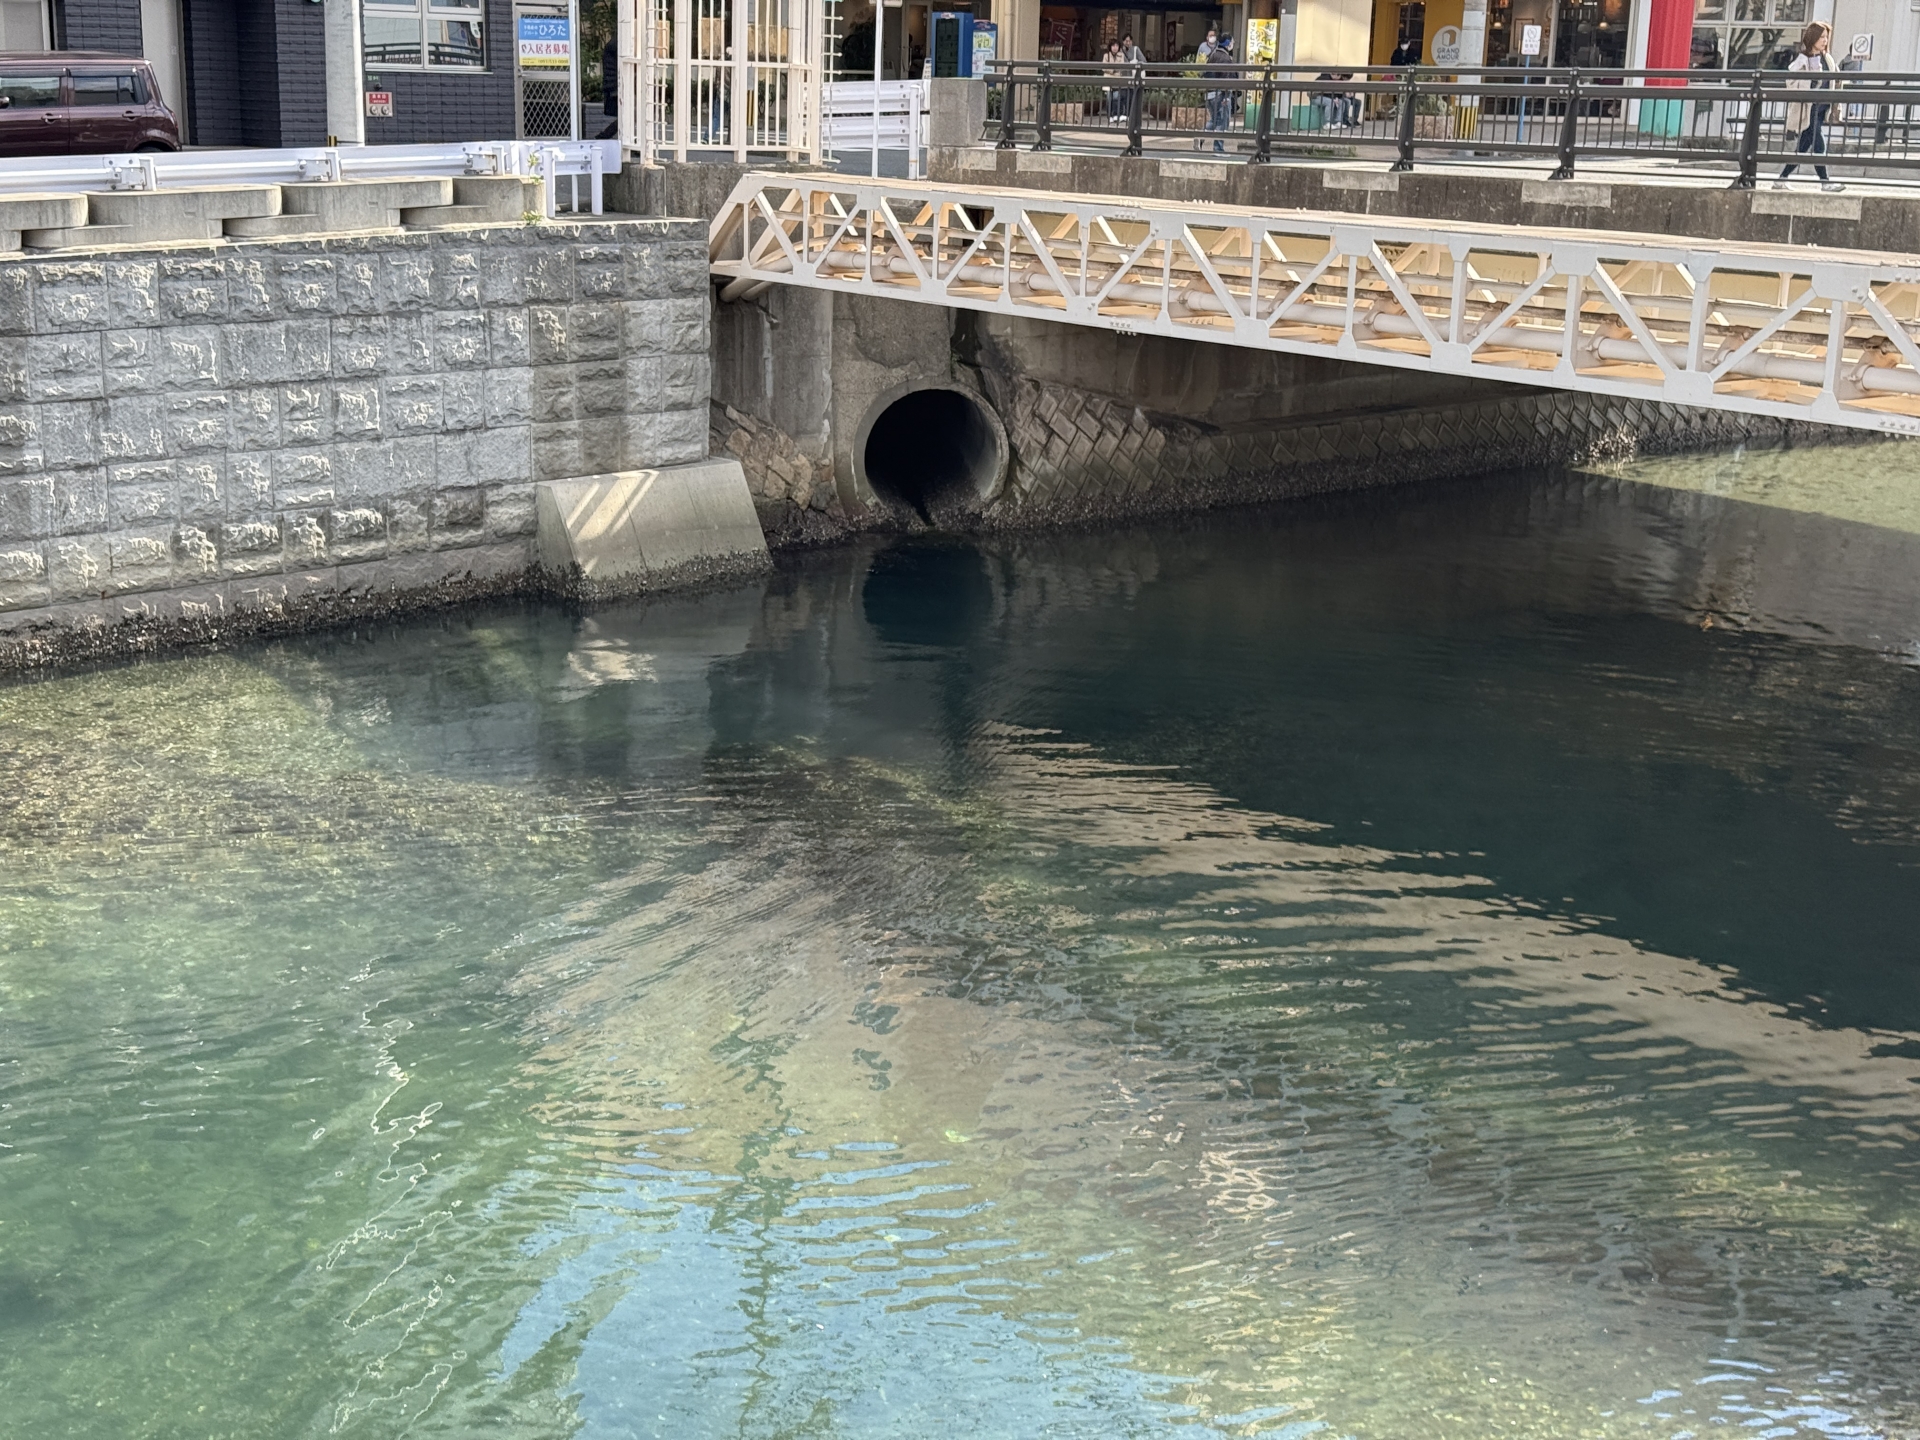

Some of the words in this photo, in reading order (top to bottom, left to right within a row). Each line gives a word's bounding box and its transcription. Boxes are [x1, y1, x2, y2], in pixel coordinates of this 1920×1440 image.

[538, 24, 566, 36] ひろた
[527, 43, 570, 55] 入居者募集
